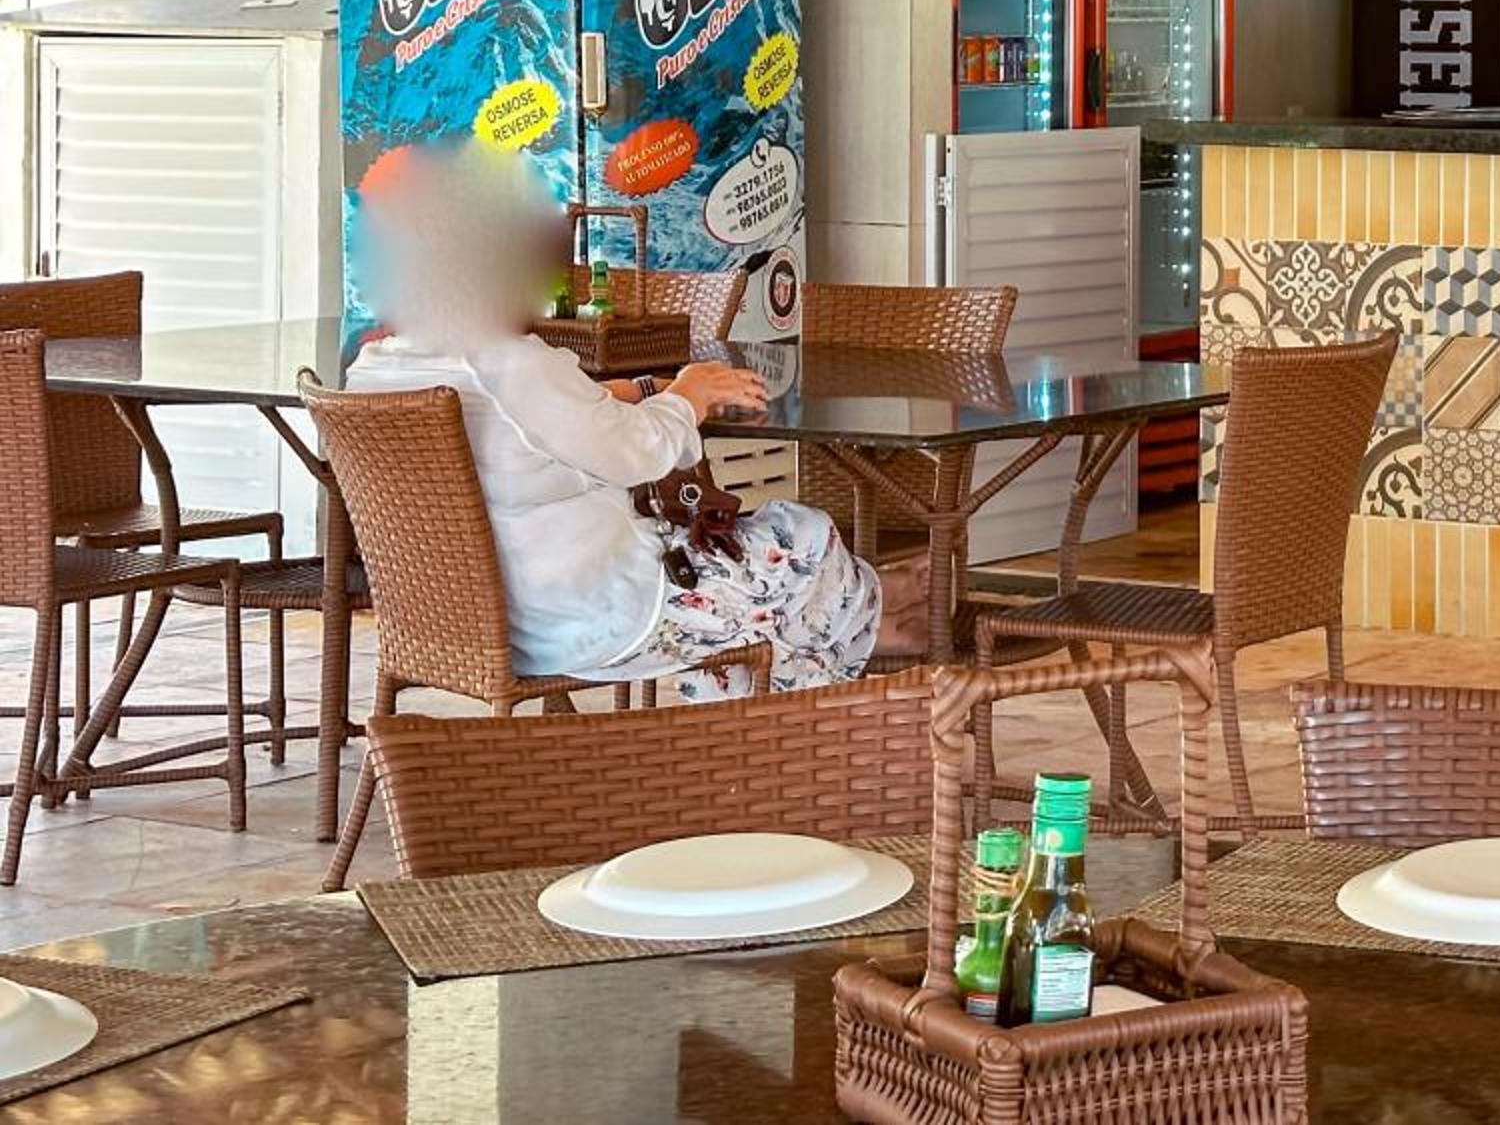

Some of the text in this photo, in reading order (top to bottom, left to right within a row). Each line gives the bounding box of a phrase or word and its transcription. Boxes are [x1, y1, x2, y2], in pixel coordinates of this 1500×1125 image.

[395, 40, 434, 73] Puro
[433, 17, 446, 40] e
[656, 39, 697, 90] Puro
[696, 28, 708, 53] e
[754, 42, 786, 80] OSMOSE
[758, 59, 793, 102] REVERSA
[486, 87, 537, 124] OSMOSE
[492, 106, 549, 142] REVERSA
